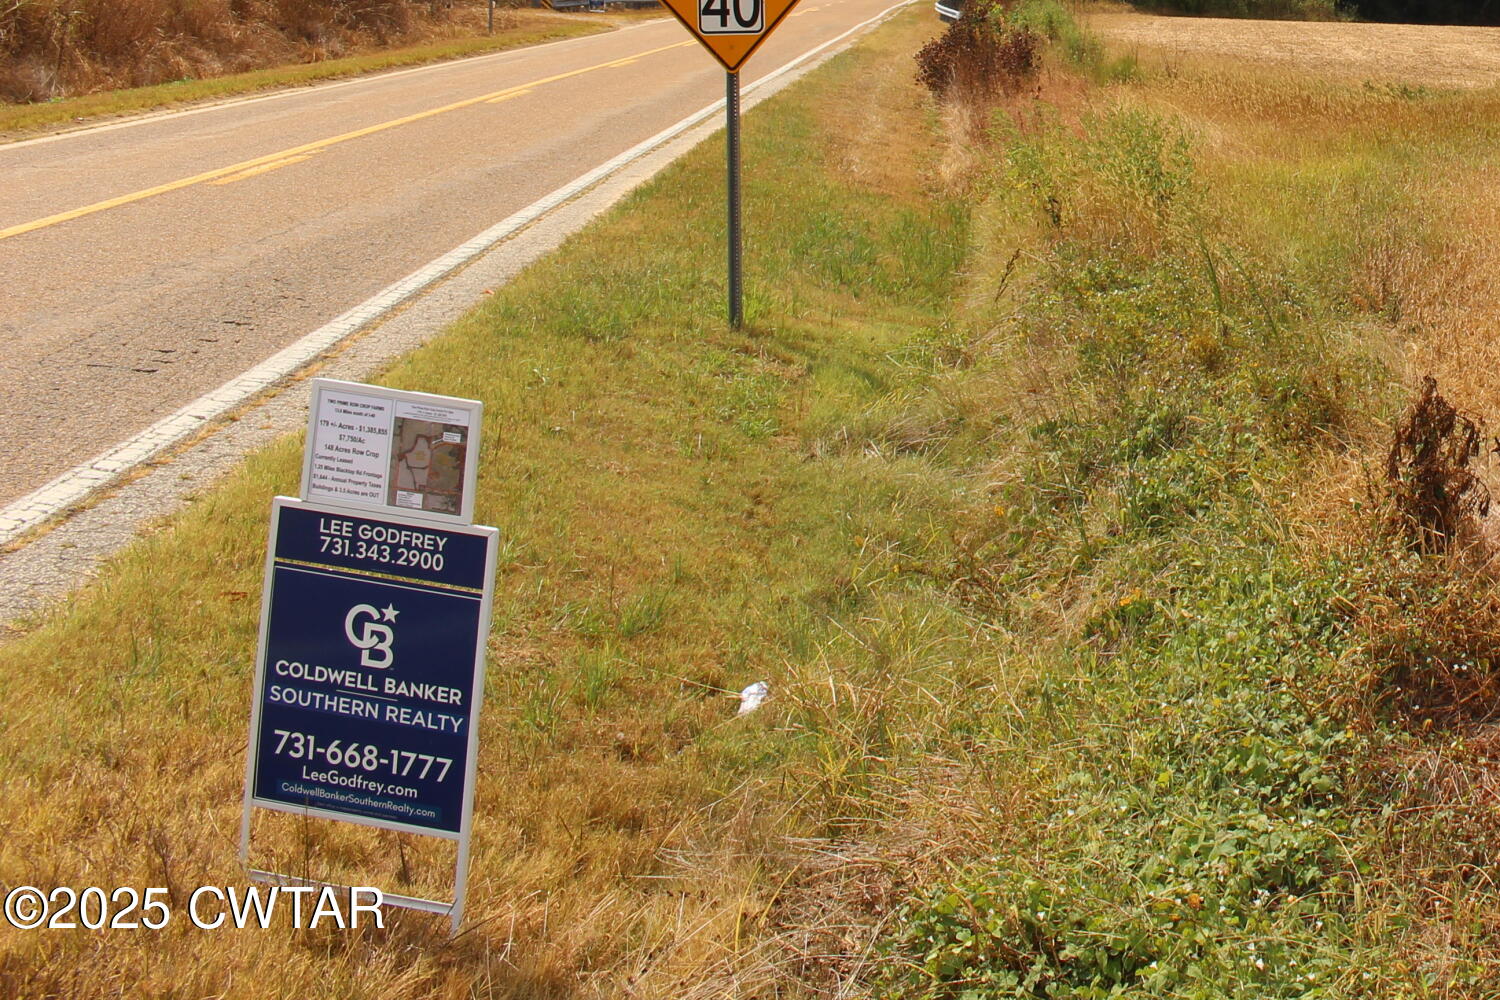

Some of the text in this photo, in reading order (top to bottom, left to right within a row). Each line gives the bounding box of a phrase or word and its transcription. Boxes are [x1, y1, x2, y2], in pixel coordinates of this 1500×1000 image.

[338, 422, 354, 430] Acres
[335, 445, 351, 454] Acres
[352, 447, 364, 455] Row
[365, 449, 380, 459] Crop
[320, 518, 448, 551] LEE GODFREY
[320, 536, 444, 571] 731.343.2900
[275, 660, 463, 705] COLDWELL BANKER
[270, 685, 464, 733] SOUTHERN REALTY
[273, 729, 453, 783] 731-668-1777
[302, 766, 418, 798] LeeGodfrey.com
[281, 782, 436, 818] ColdwellBankerSouthernRealty.com
